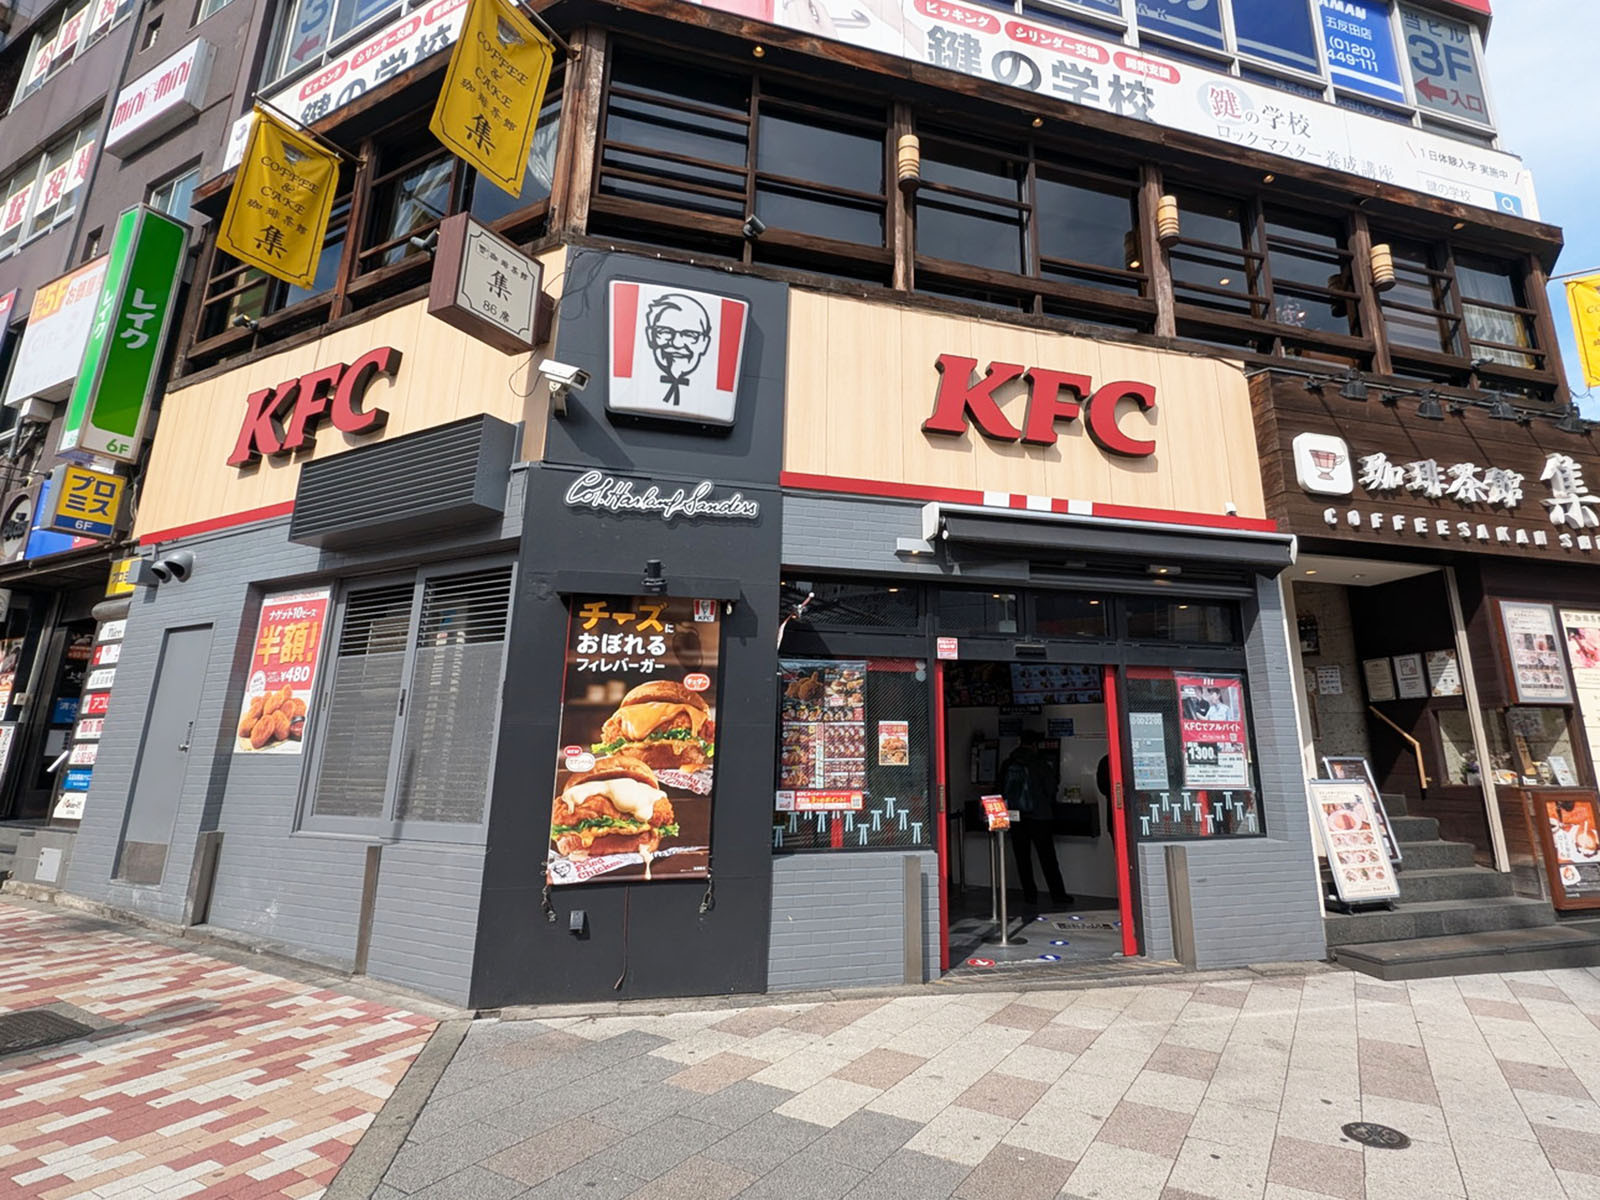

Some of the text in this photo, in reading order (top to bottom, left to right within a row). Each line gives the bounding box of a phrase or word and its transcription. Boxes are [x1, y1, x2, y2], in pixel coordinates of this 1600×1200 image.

[1015, 26, 1101, 60] シリンダー交換
[1326, 15, 1373, 41] 五反田店
[1404, 12, 1465, 44] 当ビル
[476, 31, 529, 87] COFFEE
[1329, 35, 1376, 61] (0120)
[1408, 34, 1473, 82] 3F
[475, 66, 513, 110] CAKE
[490, 67, 505, 81] &
[927, 25, 1156, 124] 鍵の学校
[1209, 87, 1313, 139] 鍵の学校
[1451, 88, 1484, 114] 入口
[464, 113, 497, 157] 集
[260, 155, 320, 195] COFFEE
[281, 182, 295, 194] &
[260, 185, 307, 217] CAKE
[254, 224, 288, 260] 集
[487, 269, 513, 302] 集
[94, 290, 114, 340] レイク
[120, 287, 154, 349] レイク
[226, 346, 404, 469] KFC
[921, 353, 1157, 458] KFC
[106, 438, 130, 455] 6F
[72, 474, 117, 499] プロ
[1357, 451, 1525, 509] 珈琲茶館
[1540, 452, 1600, 530] 集
[65, 493, 109, 516] ミス
[600, 480, 684, 518] Harland
[682, 480, 759, 517] Sanders
[75, 519, 94, 531] 6F
[256, 621, 319, 668] 半額!
[576, 632, 667, 657] おぼれる
[280, 666, 311, 683] ¥480
[576, 657, 666, 674] フィレバーガー
[1183, 722, 1241, 732] KFCでアルバイト
[1188, 746, 1215, 760] 1300
